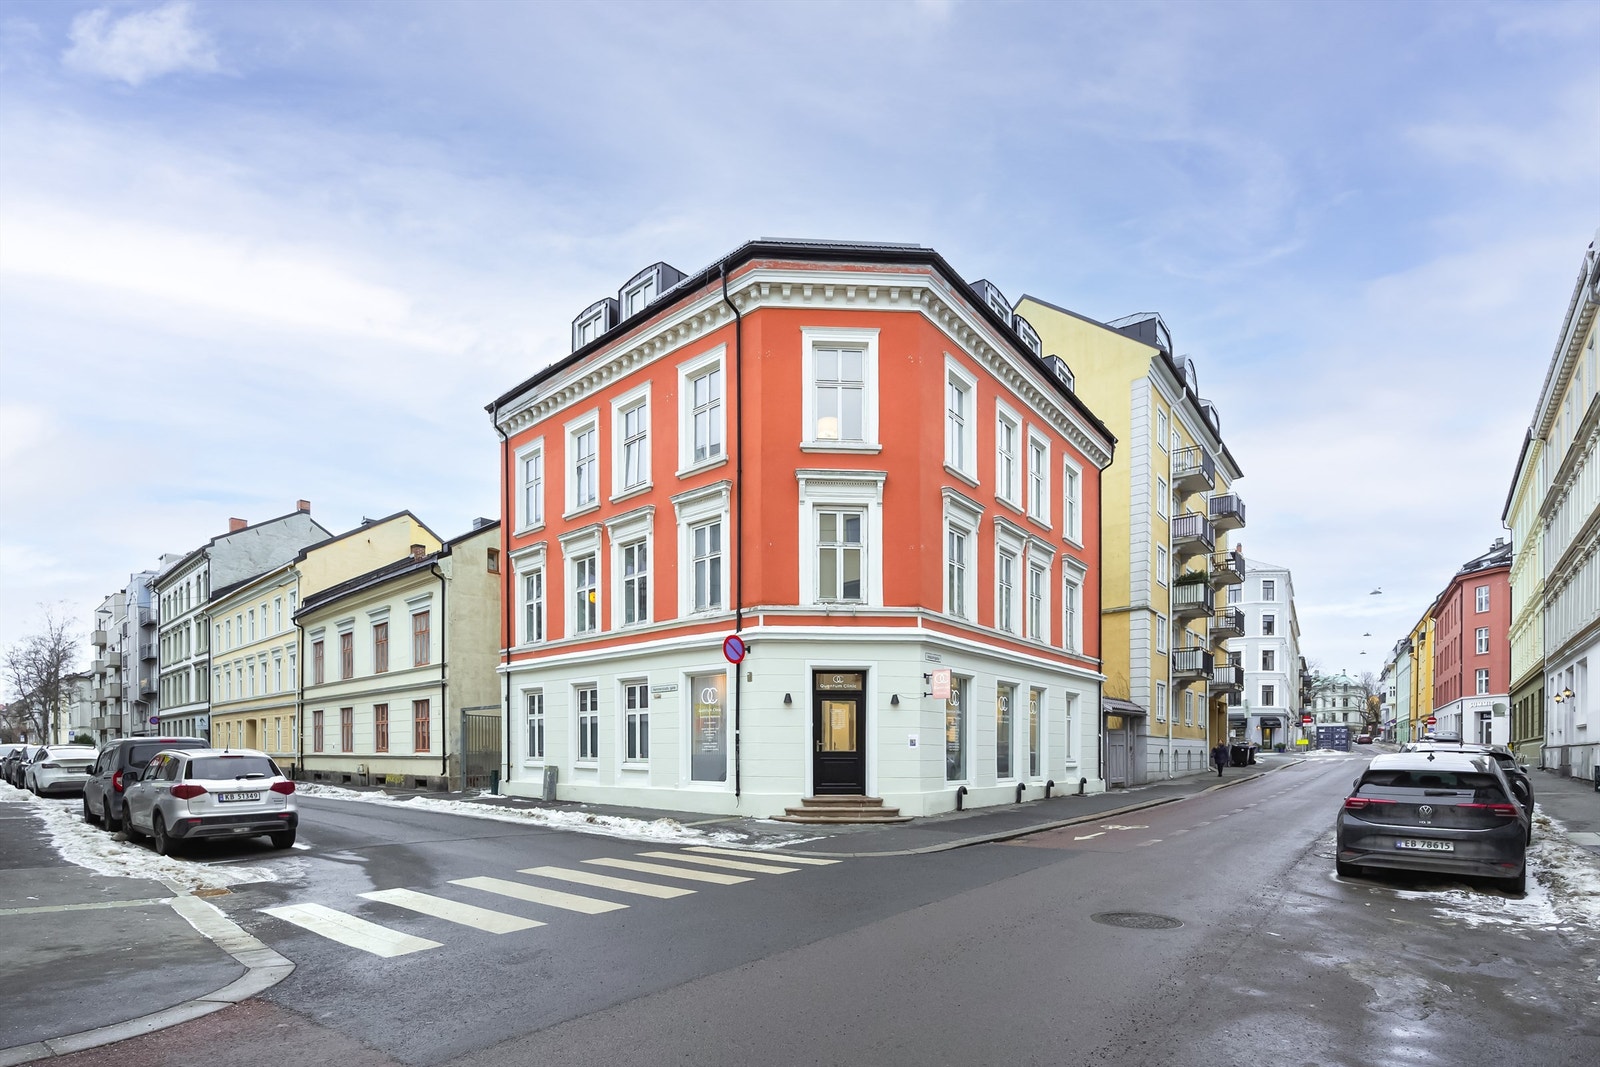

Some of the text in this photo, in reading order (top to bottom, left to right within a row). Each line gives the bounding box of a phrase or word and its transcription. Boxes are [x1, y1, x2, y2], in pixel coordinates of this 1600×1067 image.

[237, 792, 258, 800] 51349
[1404, 840, 1450, 850] EB 78615
